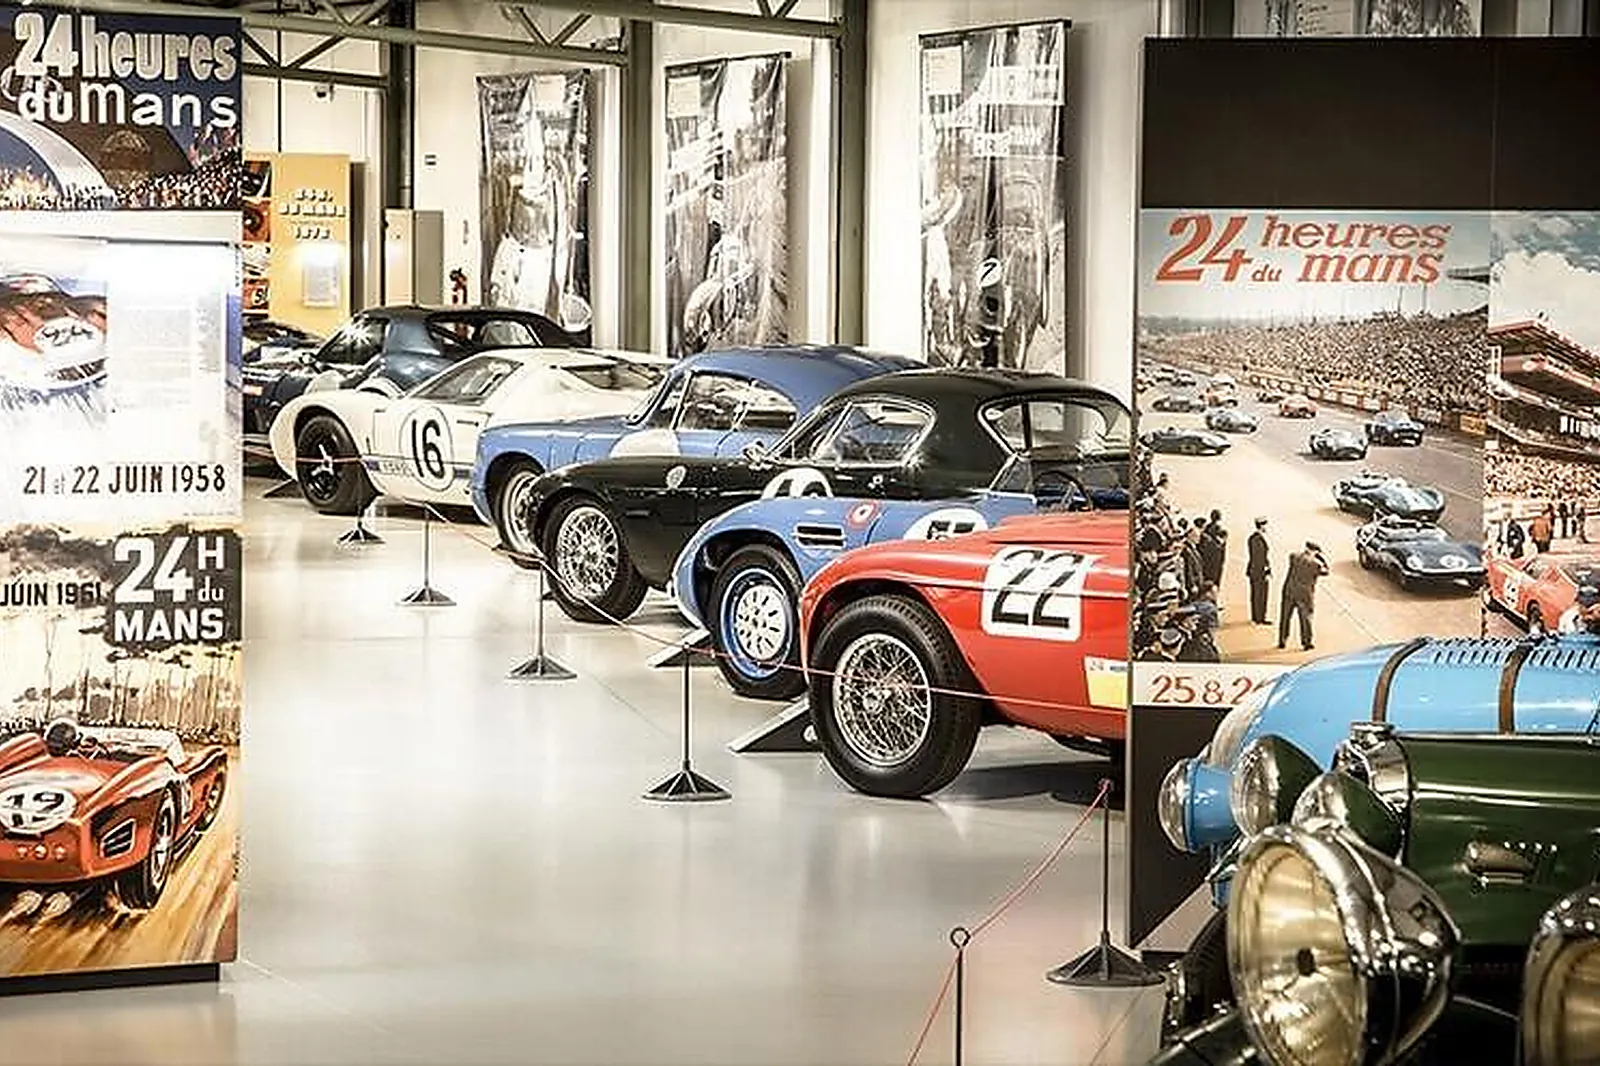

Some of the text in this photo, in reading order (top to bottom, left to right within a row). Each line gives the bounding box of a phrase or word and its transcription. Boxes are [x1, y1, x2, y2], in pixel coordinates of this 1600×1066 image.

[14, 12, 237, 81] 24 heures
[18, 78, 237, 127] du mans
[1156, 214, 1452, 282] 24 heures
[1251, 252, 1444, 283] du mans
[411, 419, 446, 480] 16
[23, 466, 46, 494] 21
[72, 465, 100, 494] 22
[108, 466, 163, 494] JUIN
[172, 464, 226, 493] 1958
[115, 536, 224, 603] 24 H
[198, 576, 224, 602] du
[991, 549, 1085, 630] 22
[0, 581, 101, 607] JUIN 1961
[114, 608, 224, 641] MANS
[1152, 675, 1196, 704] 25
[1230, 676, 1266, 706] 2
